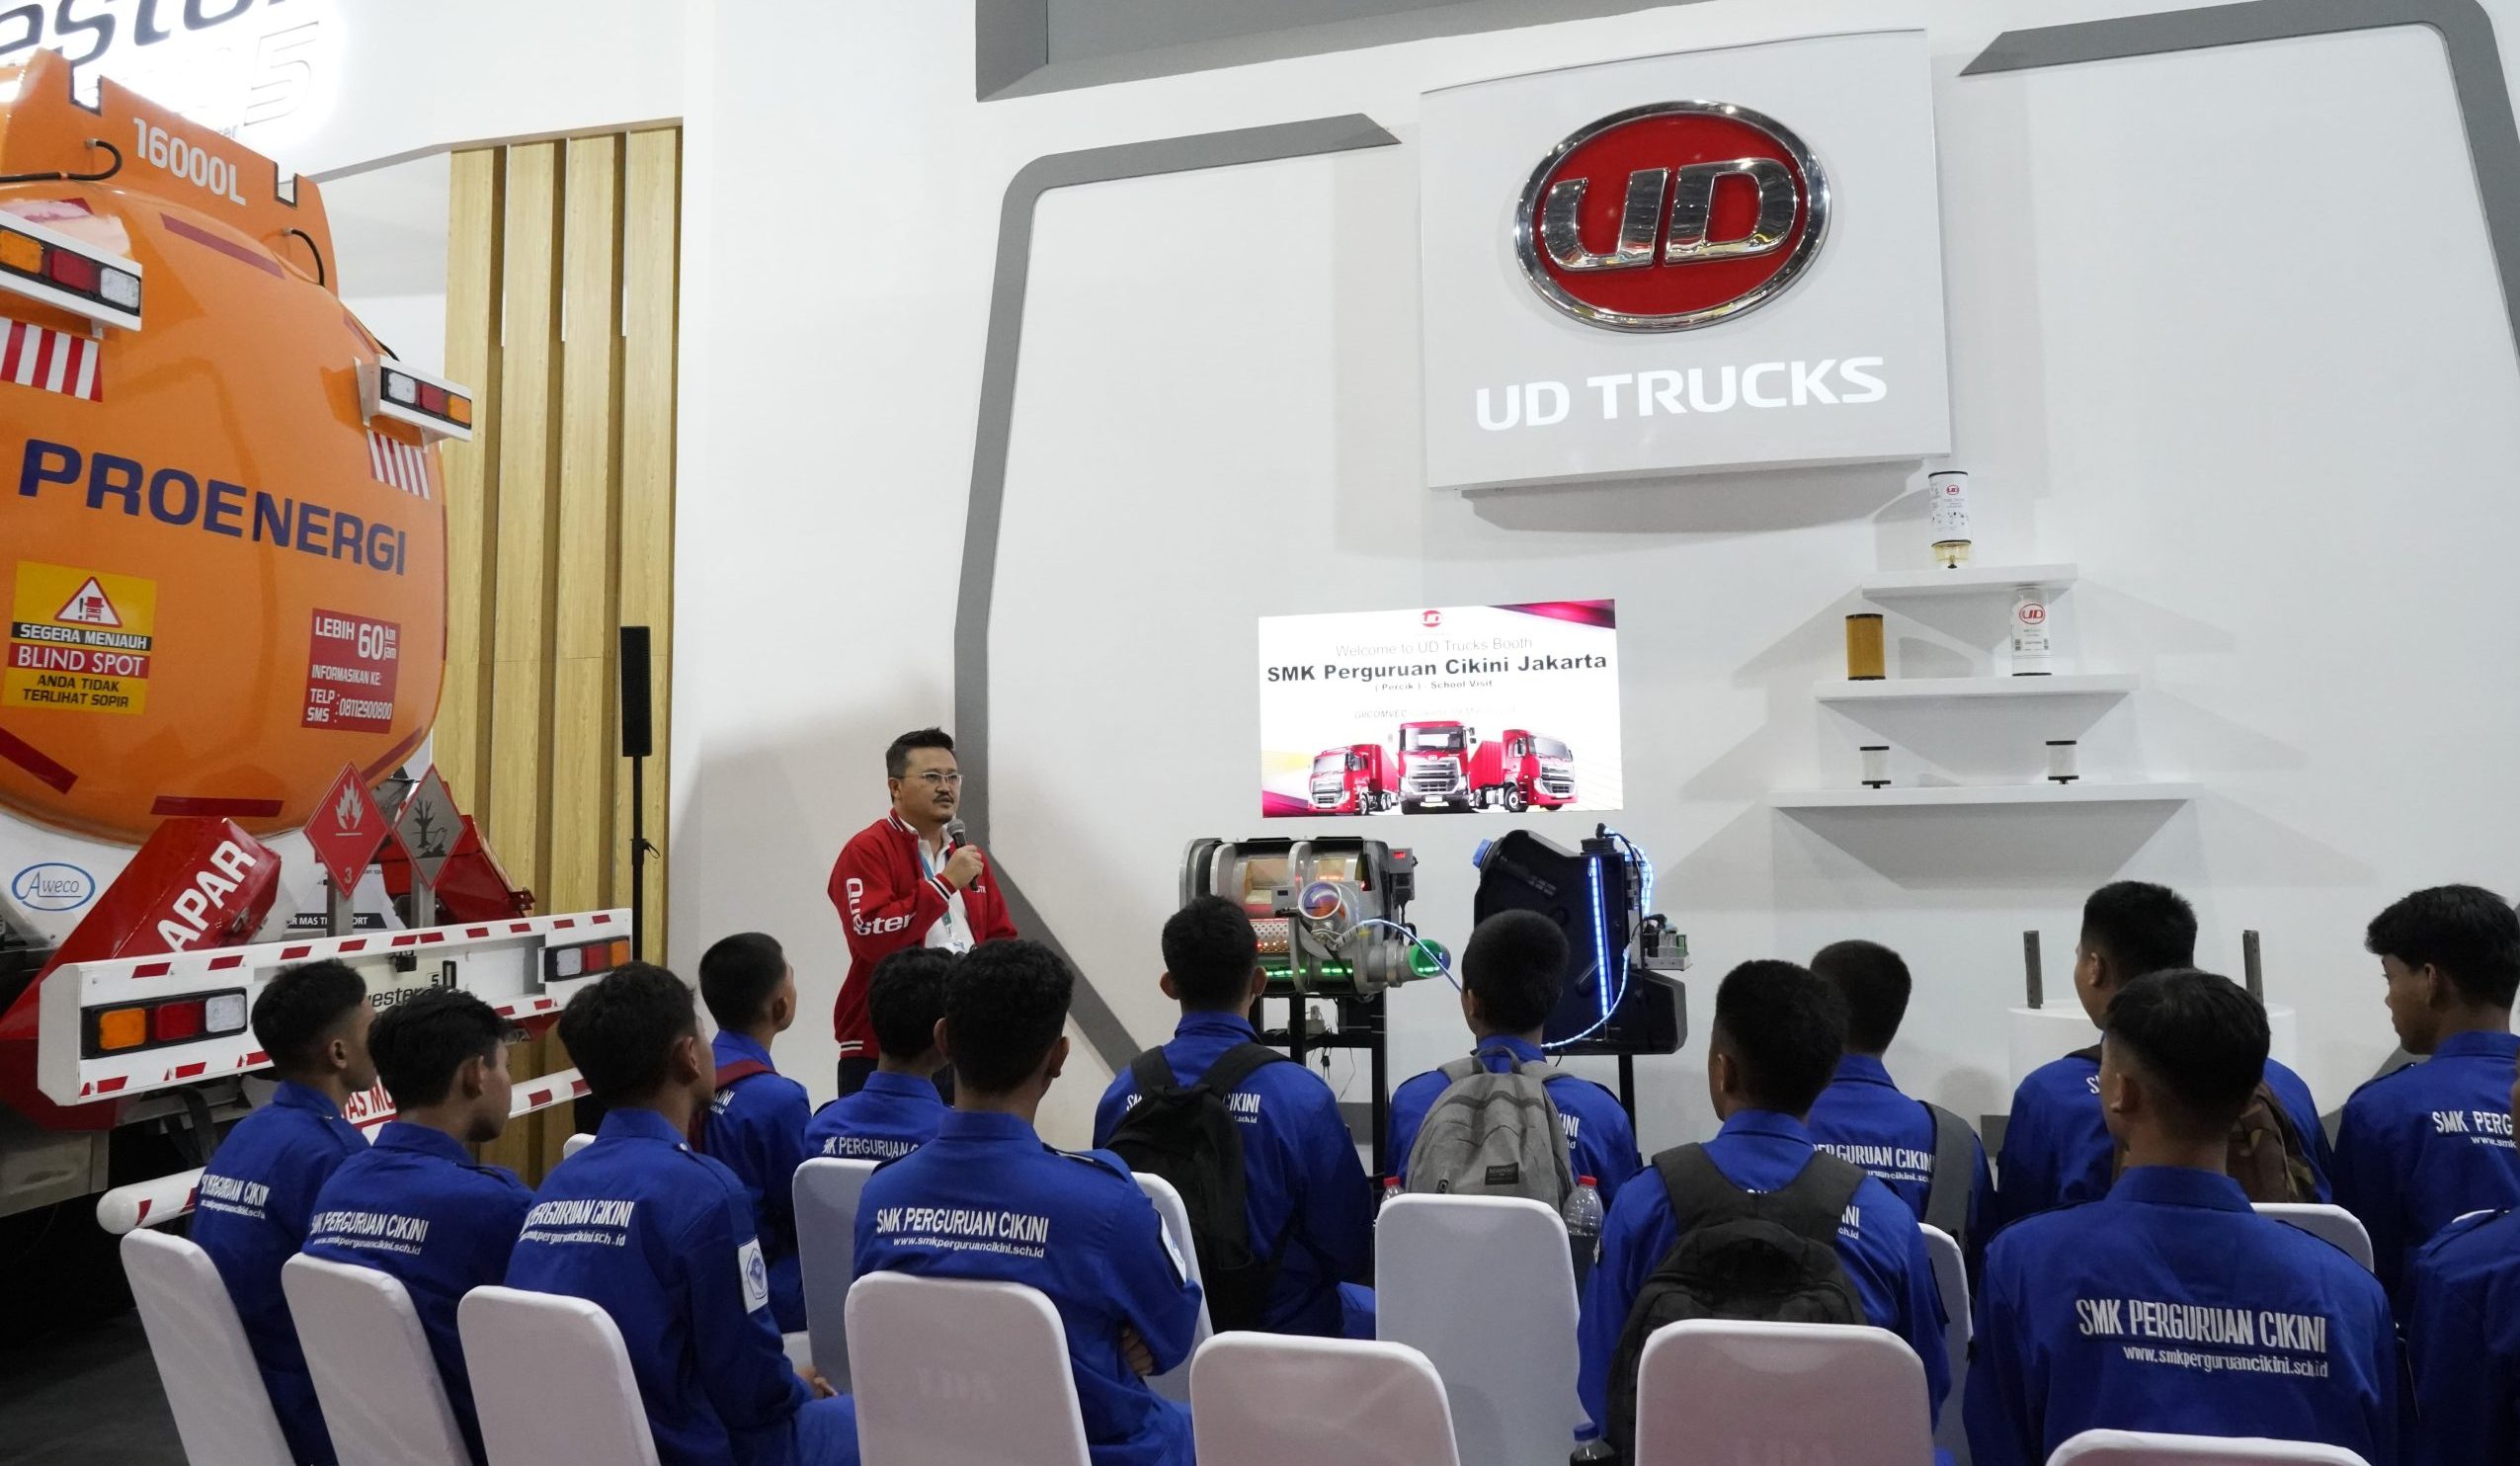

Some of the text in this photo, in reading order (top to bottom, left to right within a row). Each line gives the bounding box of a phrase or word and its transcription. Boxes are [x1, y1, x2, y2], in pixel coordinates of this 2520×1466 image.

[132, 118, 246, 206] 16000L
[1540, 158, 1801, 271] UD
[1476, 357, 1888, 432] UD TRUCKS
[18, 439, 407, 576] PROENERGI
[20, 623, 147, 649] SEGERA MENJAUH
[315, 615, 384, 661] LEBIH 60
[1336, 637, 1533, 658] Welcome to UD Trucks Booth
[18, 645, 145, 677] BLIND SPOT
[311, 664, 369, 685] INFORMASIKAN
[1267, 653, 1607, 683] SMK Perguruan Cikini Jakarta
[37, 674, 121, 692] ANDA TIDAK
[310, 688, 336, 704] TELP
[23, 688, 128, 708] TERLIHAT SOPIR
[306, 706, 330, 722] SMS
[24, 870, 83, 898] Aweco
[344, 867, 353, 884] 3
[157, 840, 257, 953] APAR
[432, 974, 440, 987] 5
[2432, 1110, 2470, 1133] SMK
[839, 1136, 909, 1159] PERGURUAN
[323, 1211, 387, 1236] PERGURUAN
[385, 1214, 429, 1243] CIKINI
[591, 1199, 635, 1228] CIKINI
[876, 1207, 1049, 1244] SMK PERGURUAN CIKINI
[893, 1235, 1044, 1260] www.smkperguruancikini.sch.id
[2075, 1298, 2327, 1354] SMK PERGURUAN CIKINI
